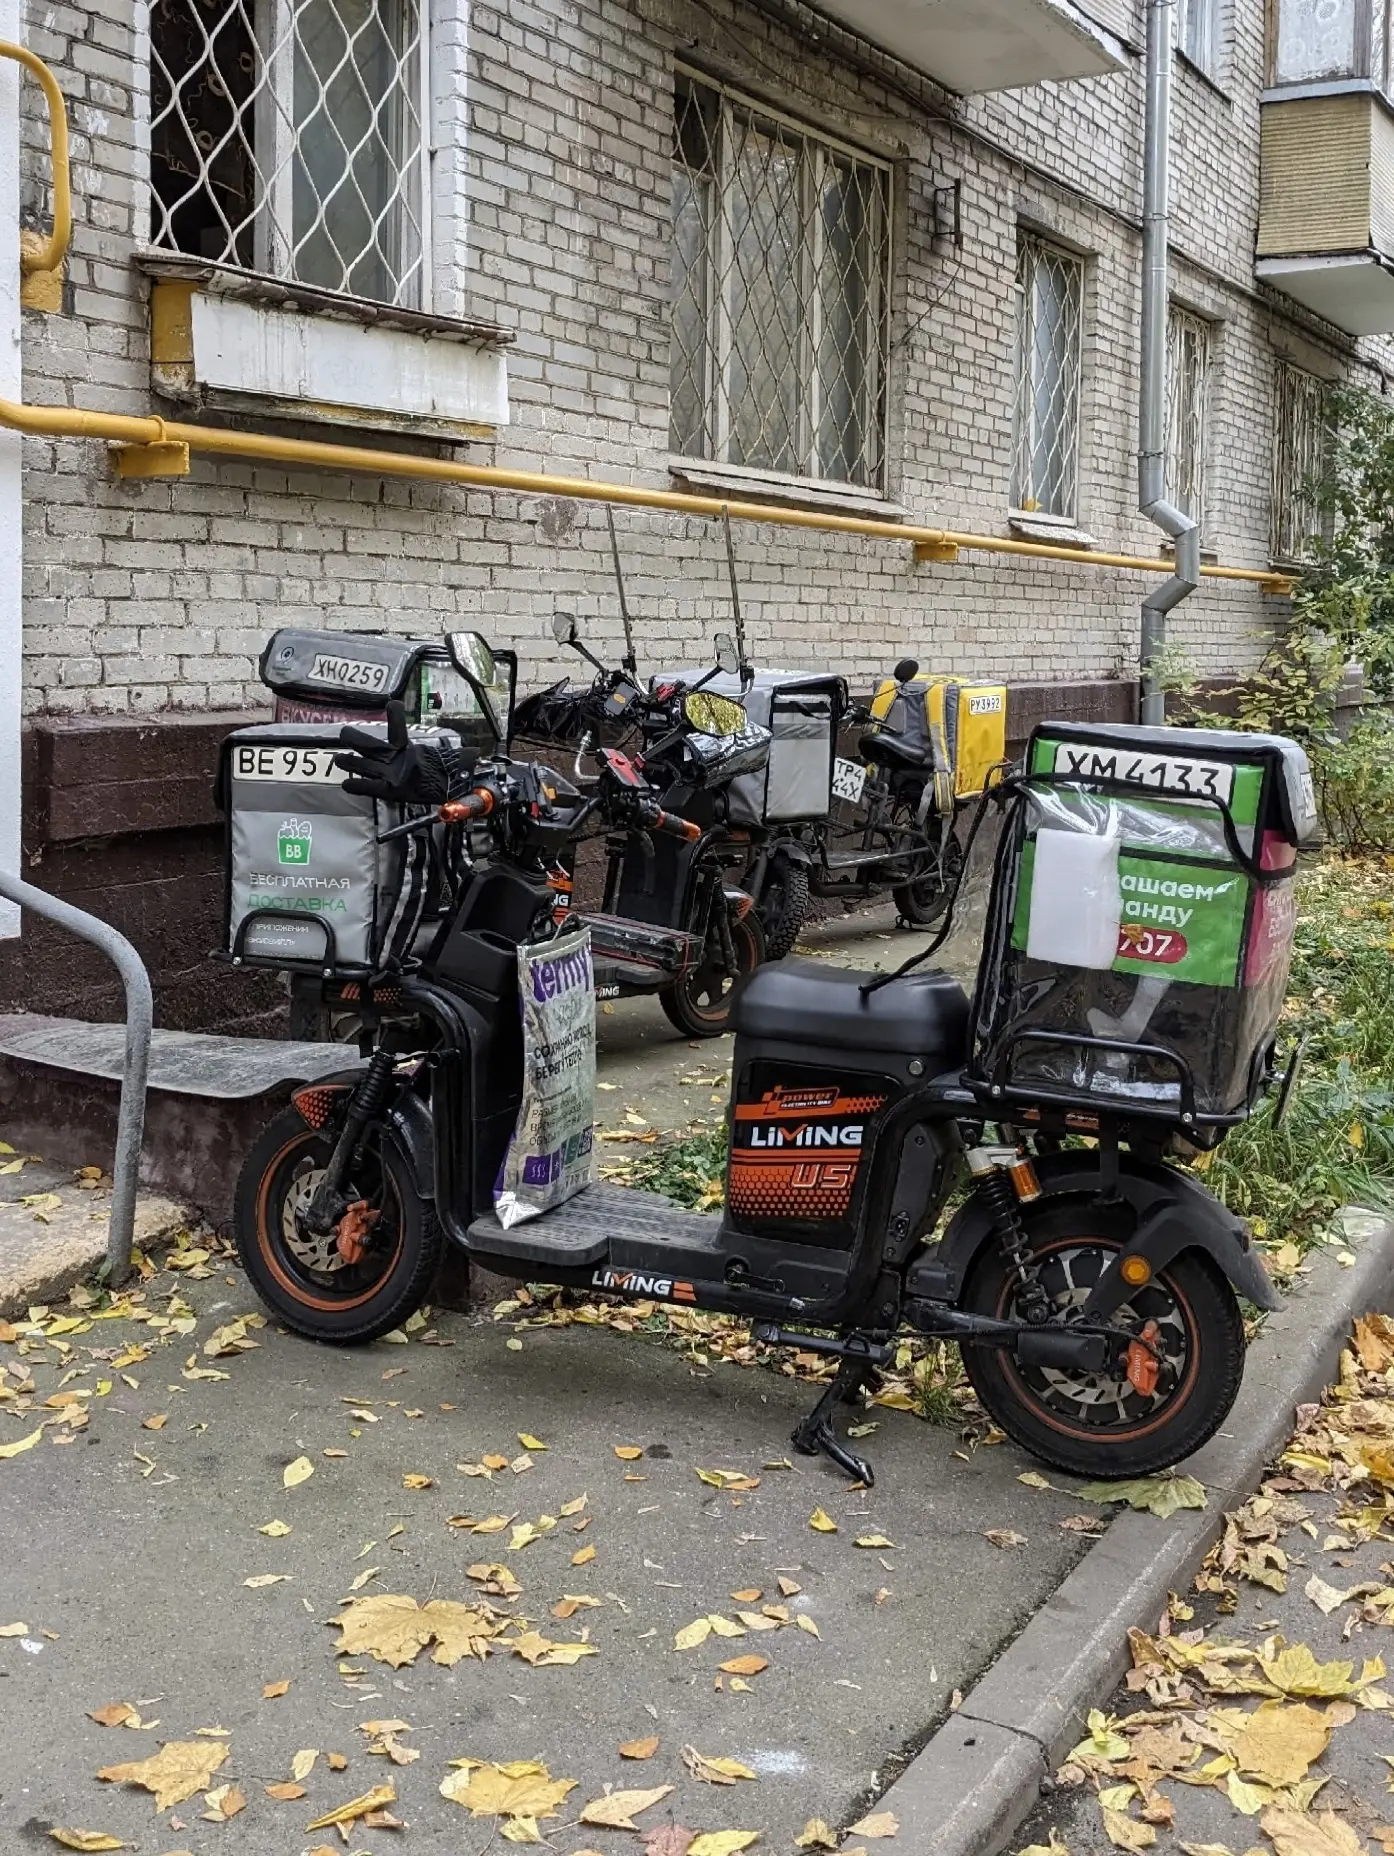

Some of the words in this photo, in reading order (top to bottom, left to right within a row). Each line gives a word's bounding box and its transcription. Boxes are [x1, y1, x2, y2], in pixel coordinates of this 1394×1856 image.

[249, 872, 351, 889] БЕСПЛАТНАЯ
[1120, 874, 1215, 902] ашаем
[246, 893, 348, 912] ДОСТАВКА
[1120, 900, 1194, 928] анду
